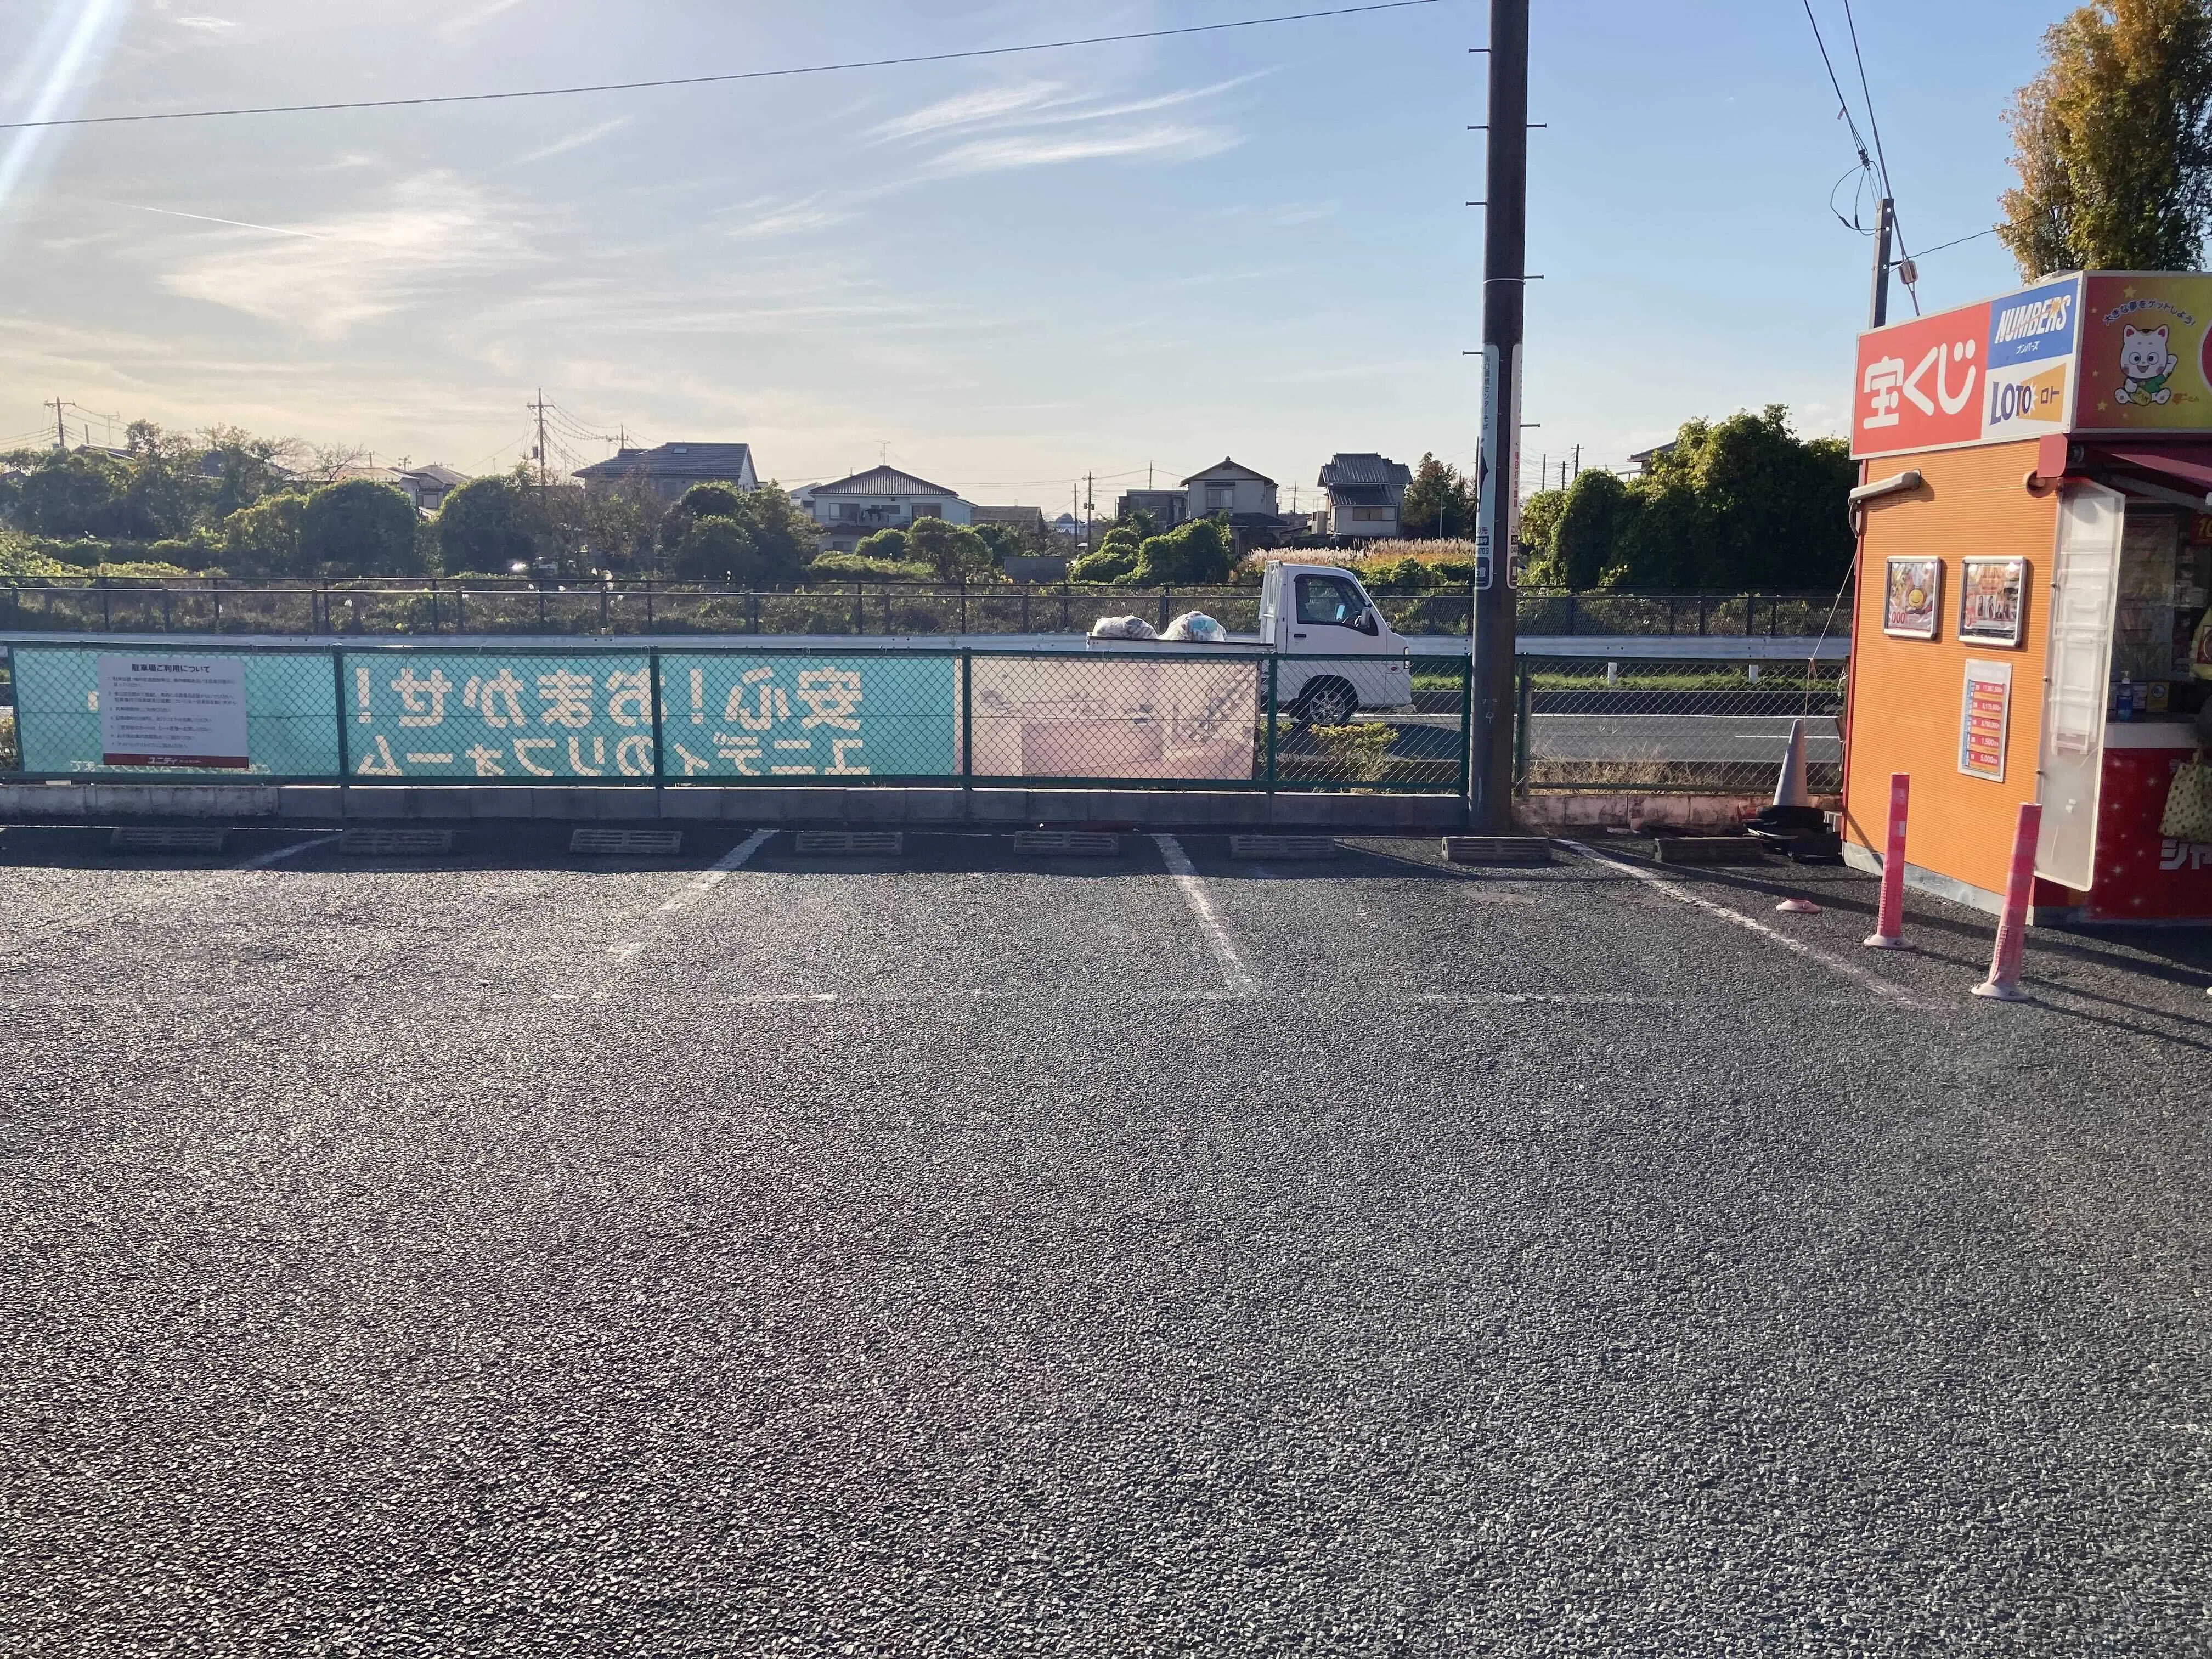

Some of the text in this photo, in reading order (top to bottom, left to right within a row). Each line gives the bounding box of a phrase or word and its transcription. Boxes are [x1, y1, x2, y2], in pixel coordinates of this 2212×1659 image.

[1994, 295, 2071, 343] NUMBERS
[1863, 339, 1976, 430] 宝くじ
[1989, 381, 2032, 425] LOTO
[2040, 387, 2061, 404] ロト
[132, 664, 211, 673] 駐車場ご利用について
